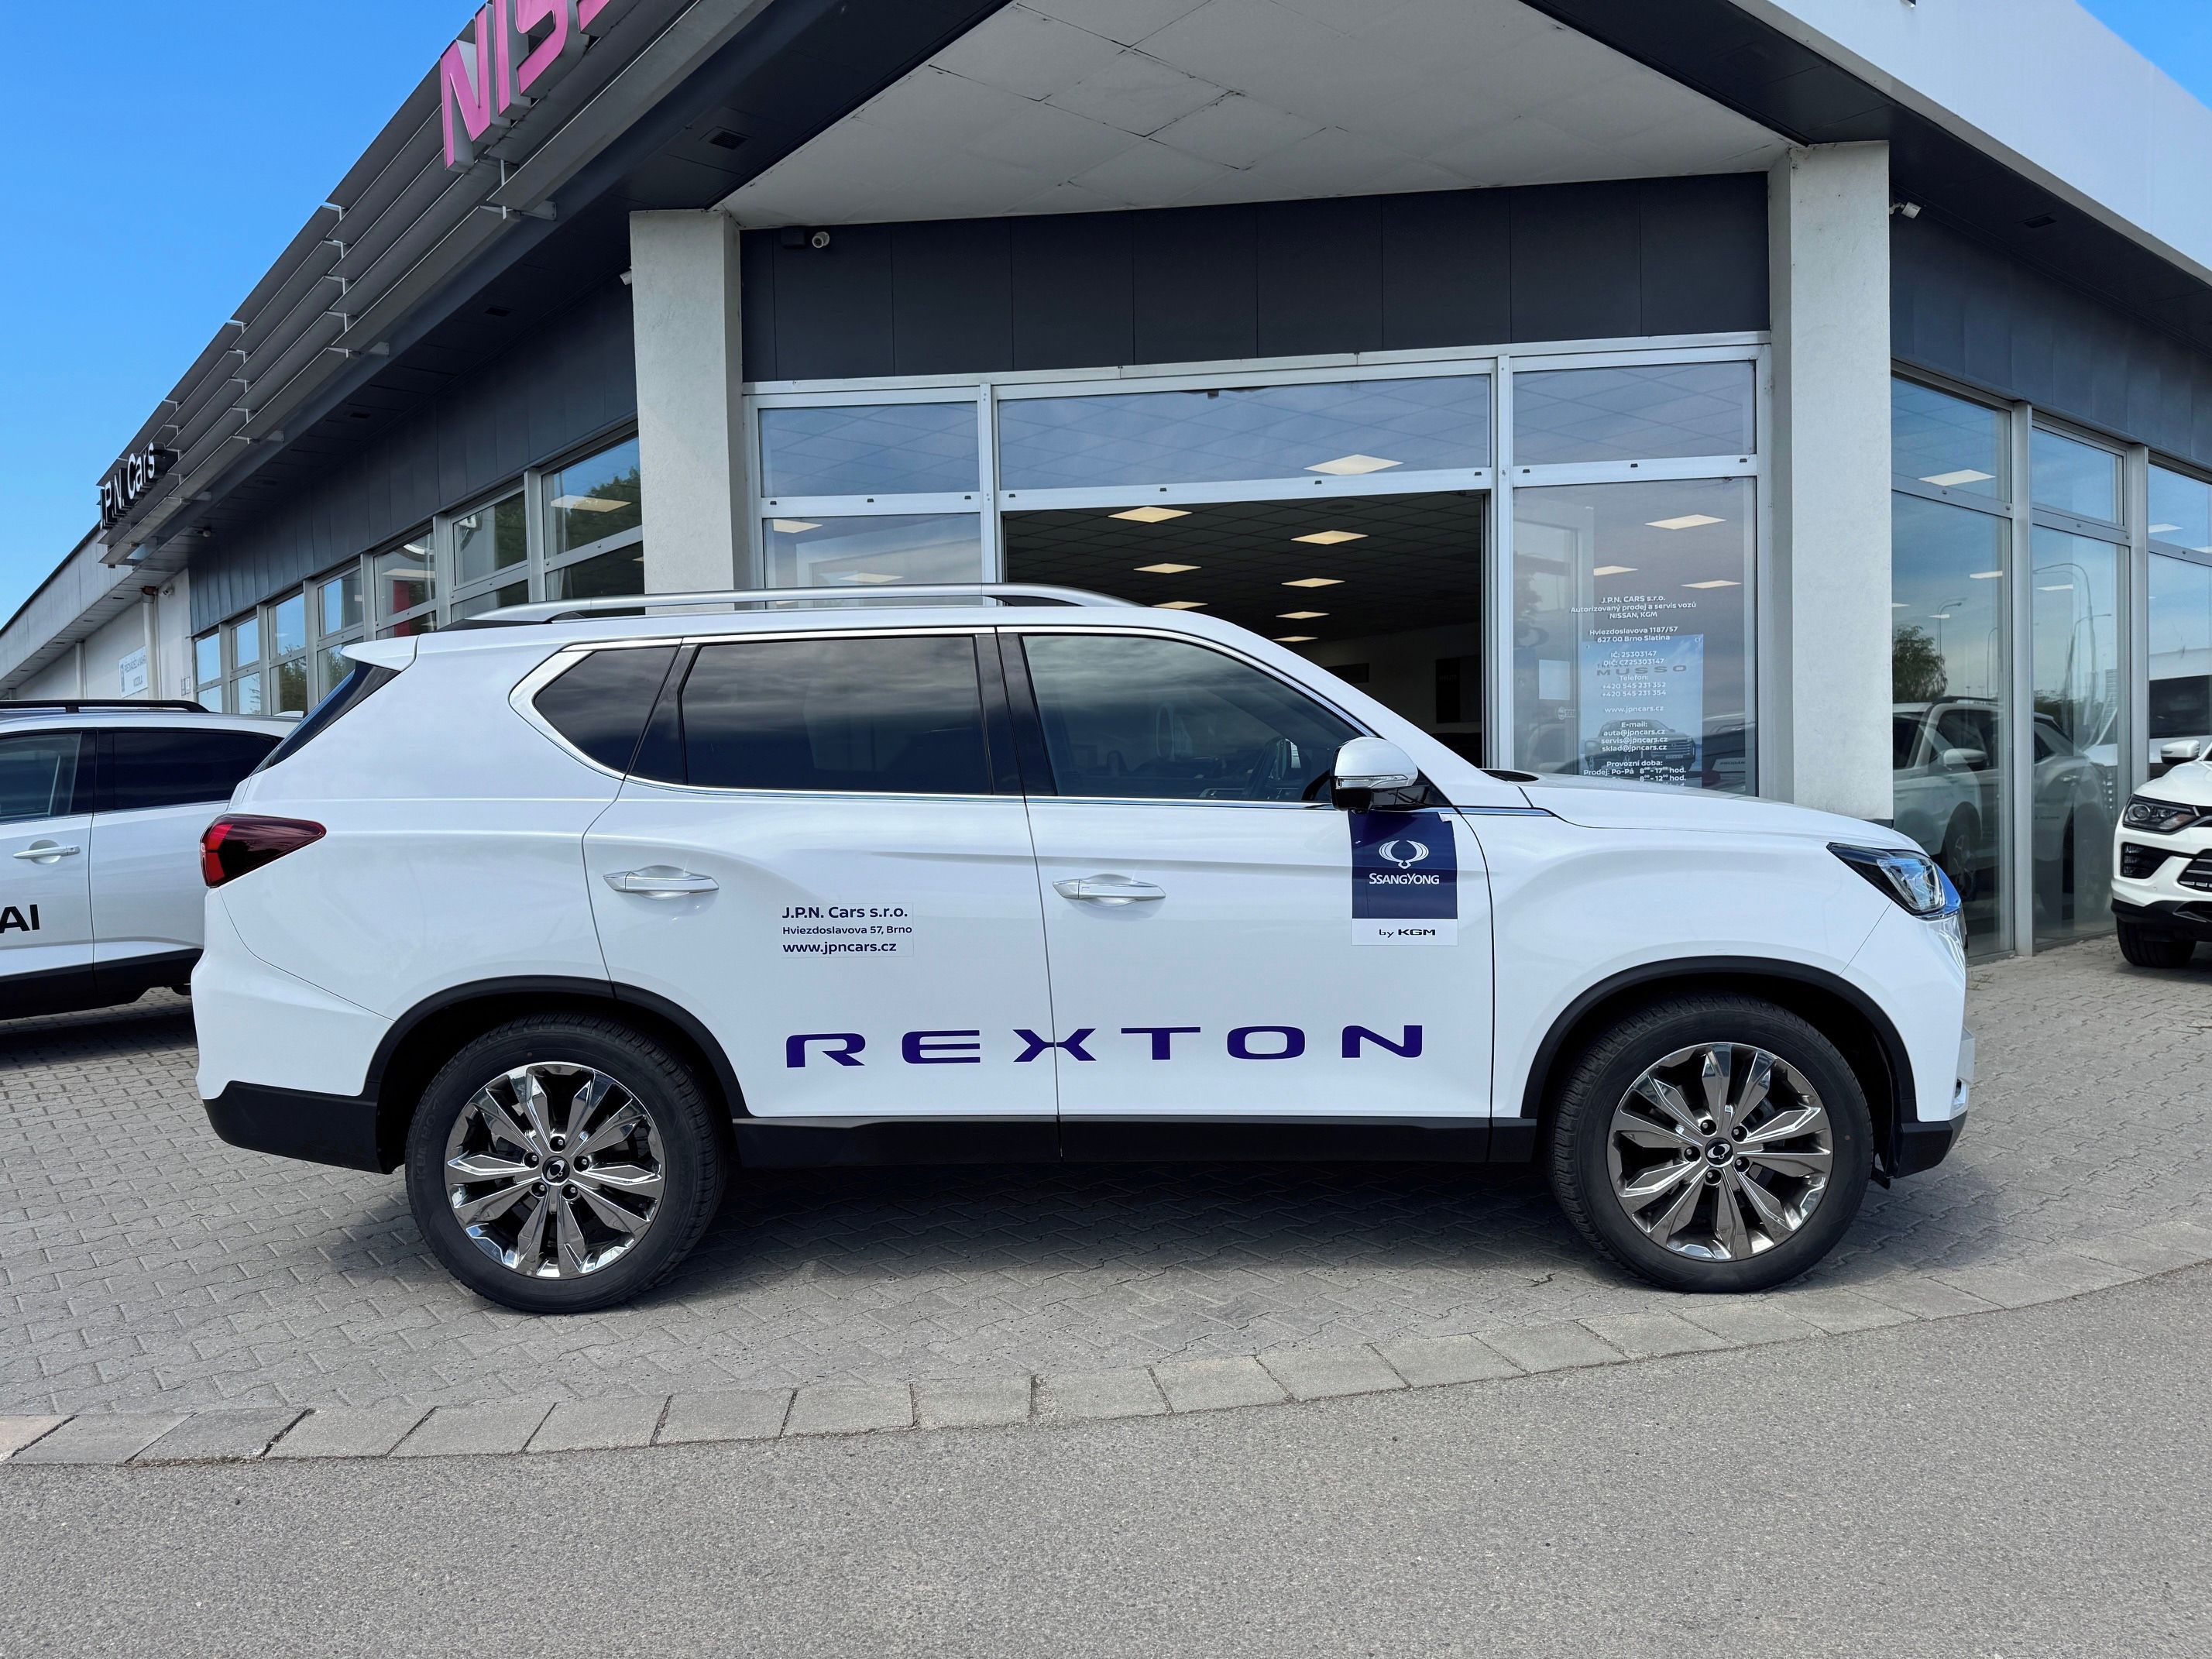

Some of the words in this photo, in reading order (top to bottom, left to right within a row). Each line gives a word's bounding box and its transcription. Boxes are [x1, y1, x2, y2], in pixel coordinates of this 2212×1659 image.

[440, 0, 610, 170] NIS
[127, 442, 155, 500] Cars
[1571, 603, 1621, 613] Autorizovaný
[1622, 603, 1647, 612] prodej
[1589, 627, 1648, 636] Hviezdoslavova
[1603, 658, 1618, 667] DIČ:
[1619, 658, 1664, 666] CZ25303147
[1596, 665, 1687, 676] MUSSO
[1604, 706, 1664, 714] www.jpncars.cz
[1603, 729, 1666, 737] auta@jpncars.cz
[1601, 737, 1668, 745] servis@jpncars.cz
[1602, 744, 1668, 753] sklad@jpncars.cz
[1583, 768, 1610, 777] Prodej:
[1669, 765, 1687, 774] hod.
[782, 906, 825, 919] J.P.N.
[828, 906, 865, 919] Cars
[869, 906, 908, 918] s.r.o.
[782, 926, 867, 935] Hviezdoslavova
[870, 926, 884, 936] 57,
[886, 926, 913, 934] Brno
[1379, 929, 1395, 939] by
[782, 941, 898, 956] www.jpncars.cz
[785, 1024, 1424, 1069] REXTON
